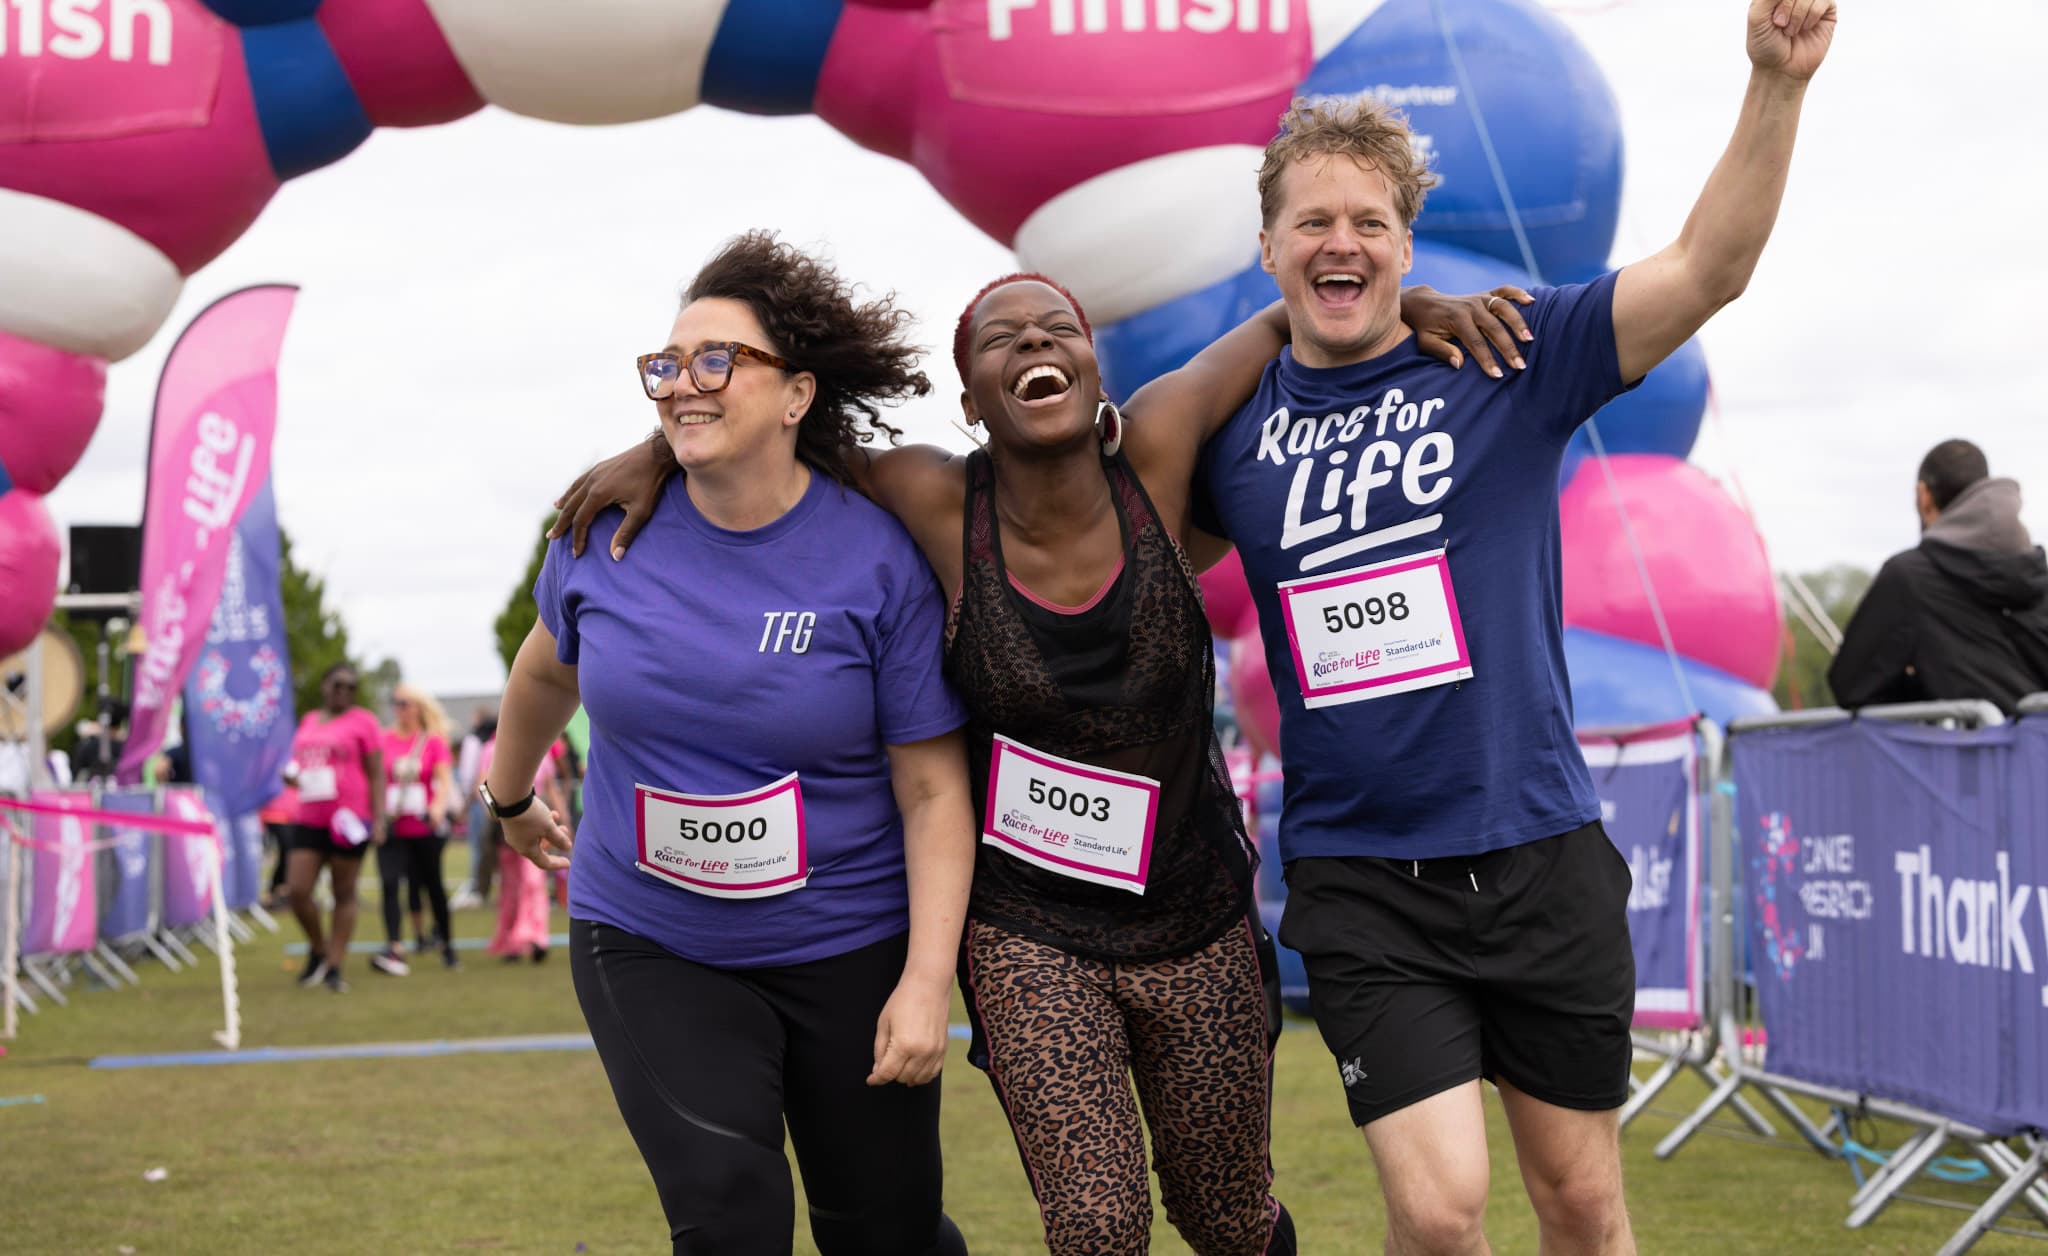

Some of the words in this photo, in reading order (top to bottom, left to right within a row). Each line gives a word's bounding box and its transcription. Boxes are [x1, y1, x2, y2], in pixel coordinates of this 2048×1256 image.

[0, 0, 173, 65] ish
[1257, 405, 1371, 465] Race
[1374, 388, 1445, 437] for
[1280, 431, 1455, 550] Life
[1322, 591, 1410, 634] 5098
[758, 610, 816, 654] TFG
[1385, 640, 1425, 656] Standard
[1424, 637, 1441, 648] Life
[1313, 658, 1339, 678] Race
[1339, 656, 1355, 671] for
[1355, 648, 1381, 667] Life
[1028, 777, 1111, 822] 5003
[679, 817, 767, 843] 5000
[1001, 813, 1028, 832] Race
[1028, 823, 1044, 836] for
[1043, 827, 1070, 844] Life
[1073, 838, 1111, 853] Standard
[1111, 845, 1128, 856] Life
[654, 849, 683, 865] Race
[684, 858, 701, 869] for
[700, 859, 730, 871] Life
[734, 856, 771, 870] Standard
[772, 855, 787, 865] Life
[1895, 844, 2035, 974] Thank
